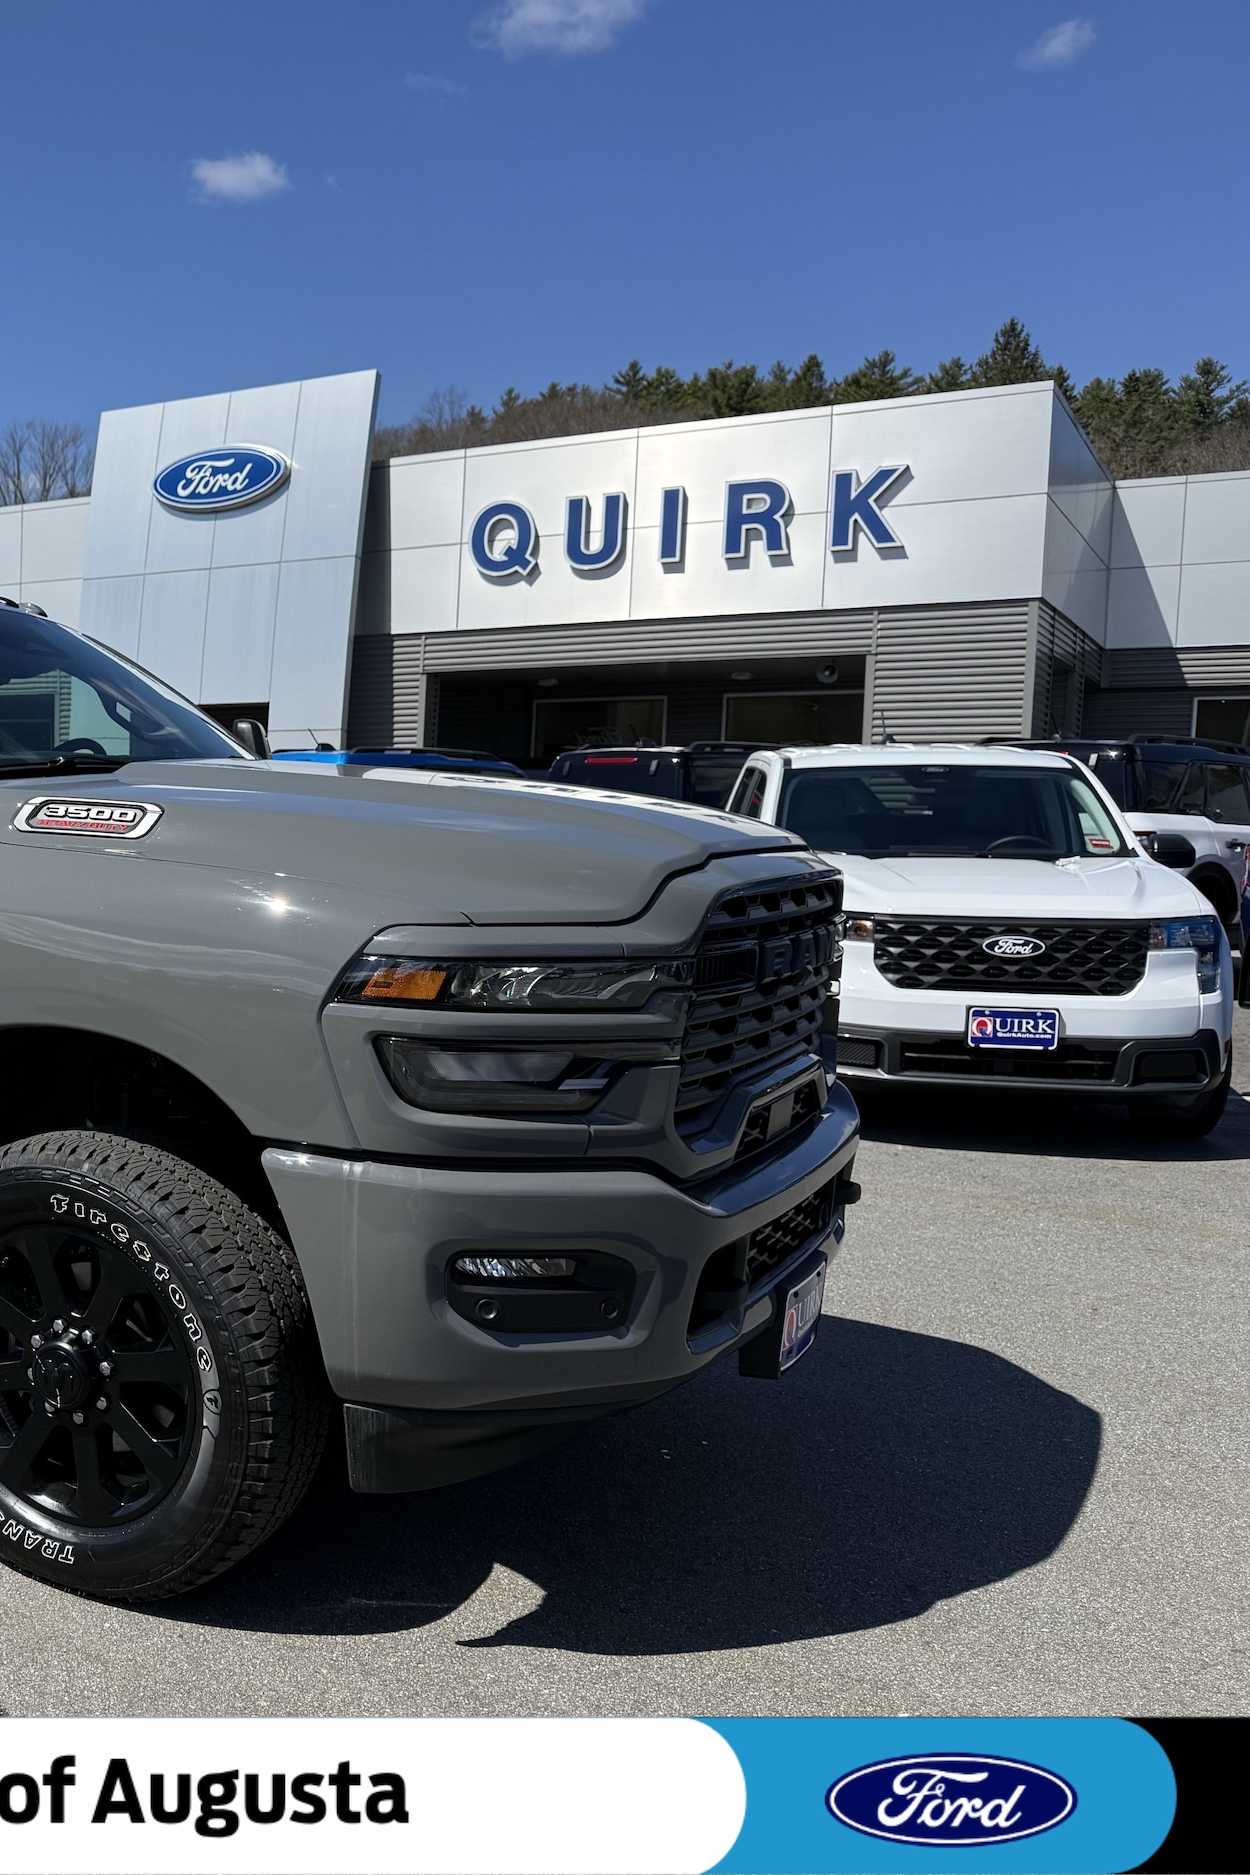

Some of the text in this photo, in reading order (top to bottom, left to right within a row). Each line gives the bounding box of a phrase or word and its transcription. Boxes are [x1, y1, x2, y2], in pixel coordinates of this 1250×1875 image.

[176, 458, 253, 497] Ford
[468, 464, 910, 577] QUIRK
[44, 804, 136, 822] 3500
[36, 818, 129, 831] HEAVY DUTY
[761, 924, 836, 984] RAM
[994, 939, 1032, 954] Ford
[971, 1017, 1055, 1037] QUIRK
[996, 1031, 1052, 1039] QuirkAuto.com
[50, 1193, 212, 1373] Firestone
